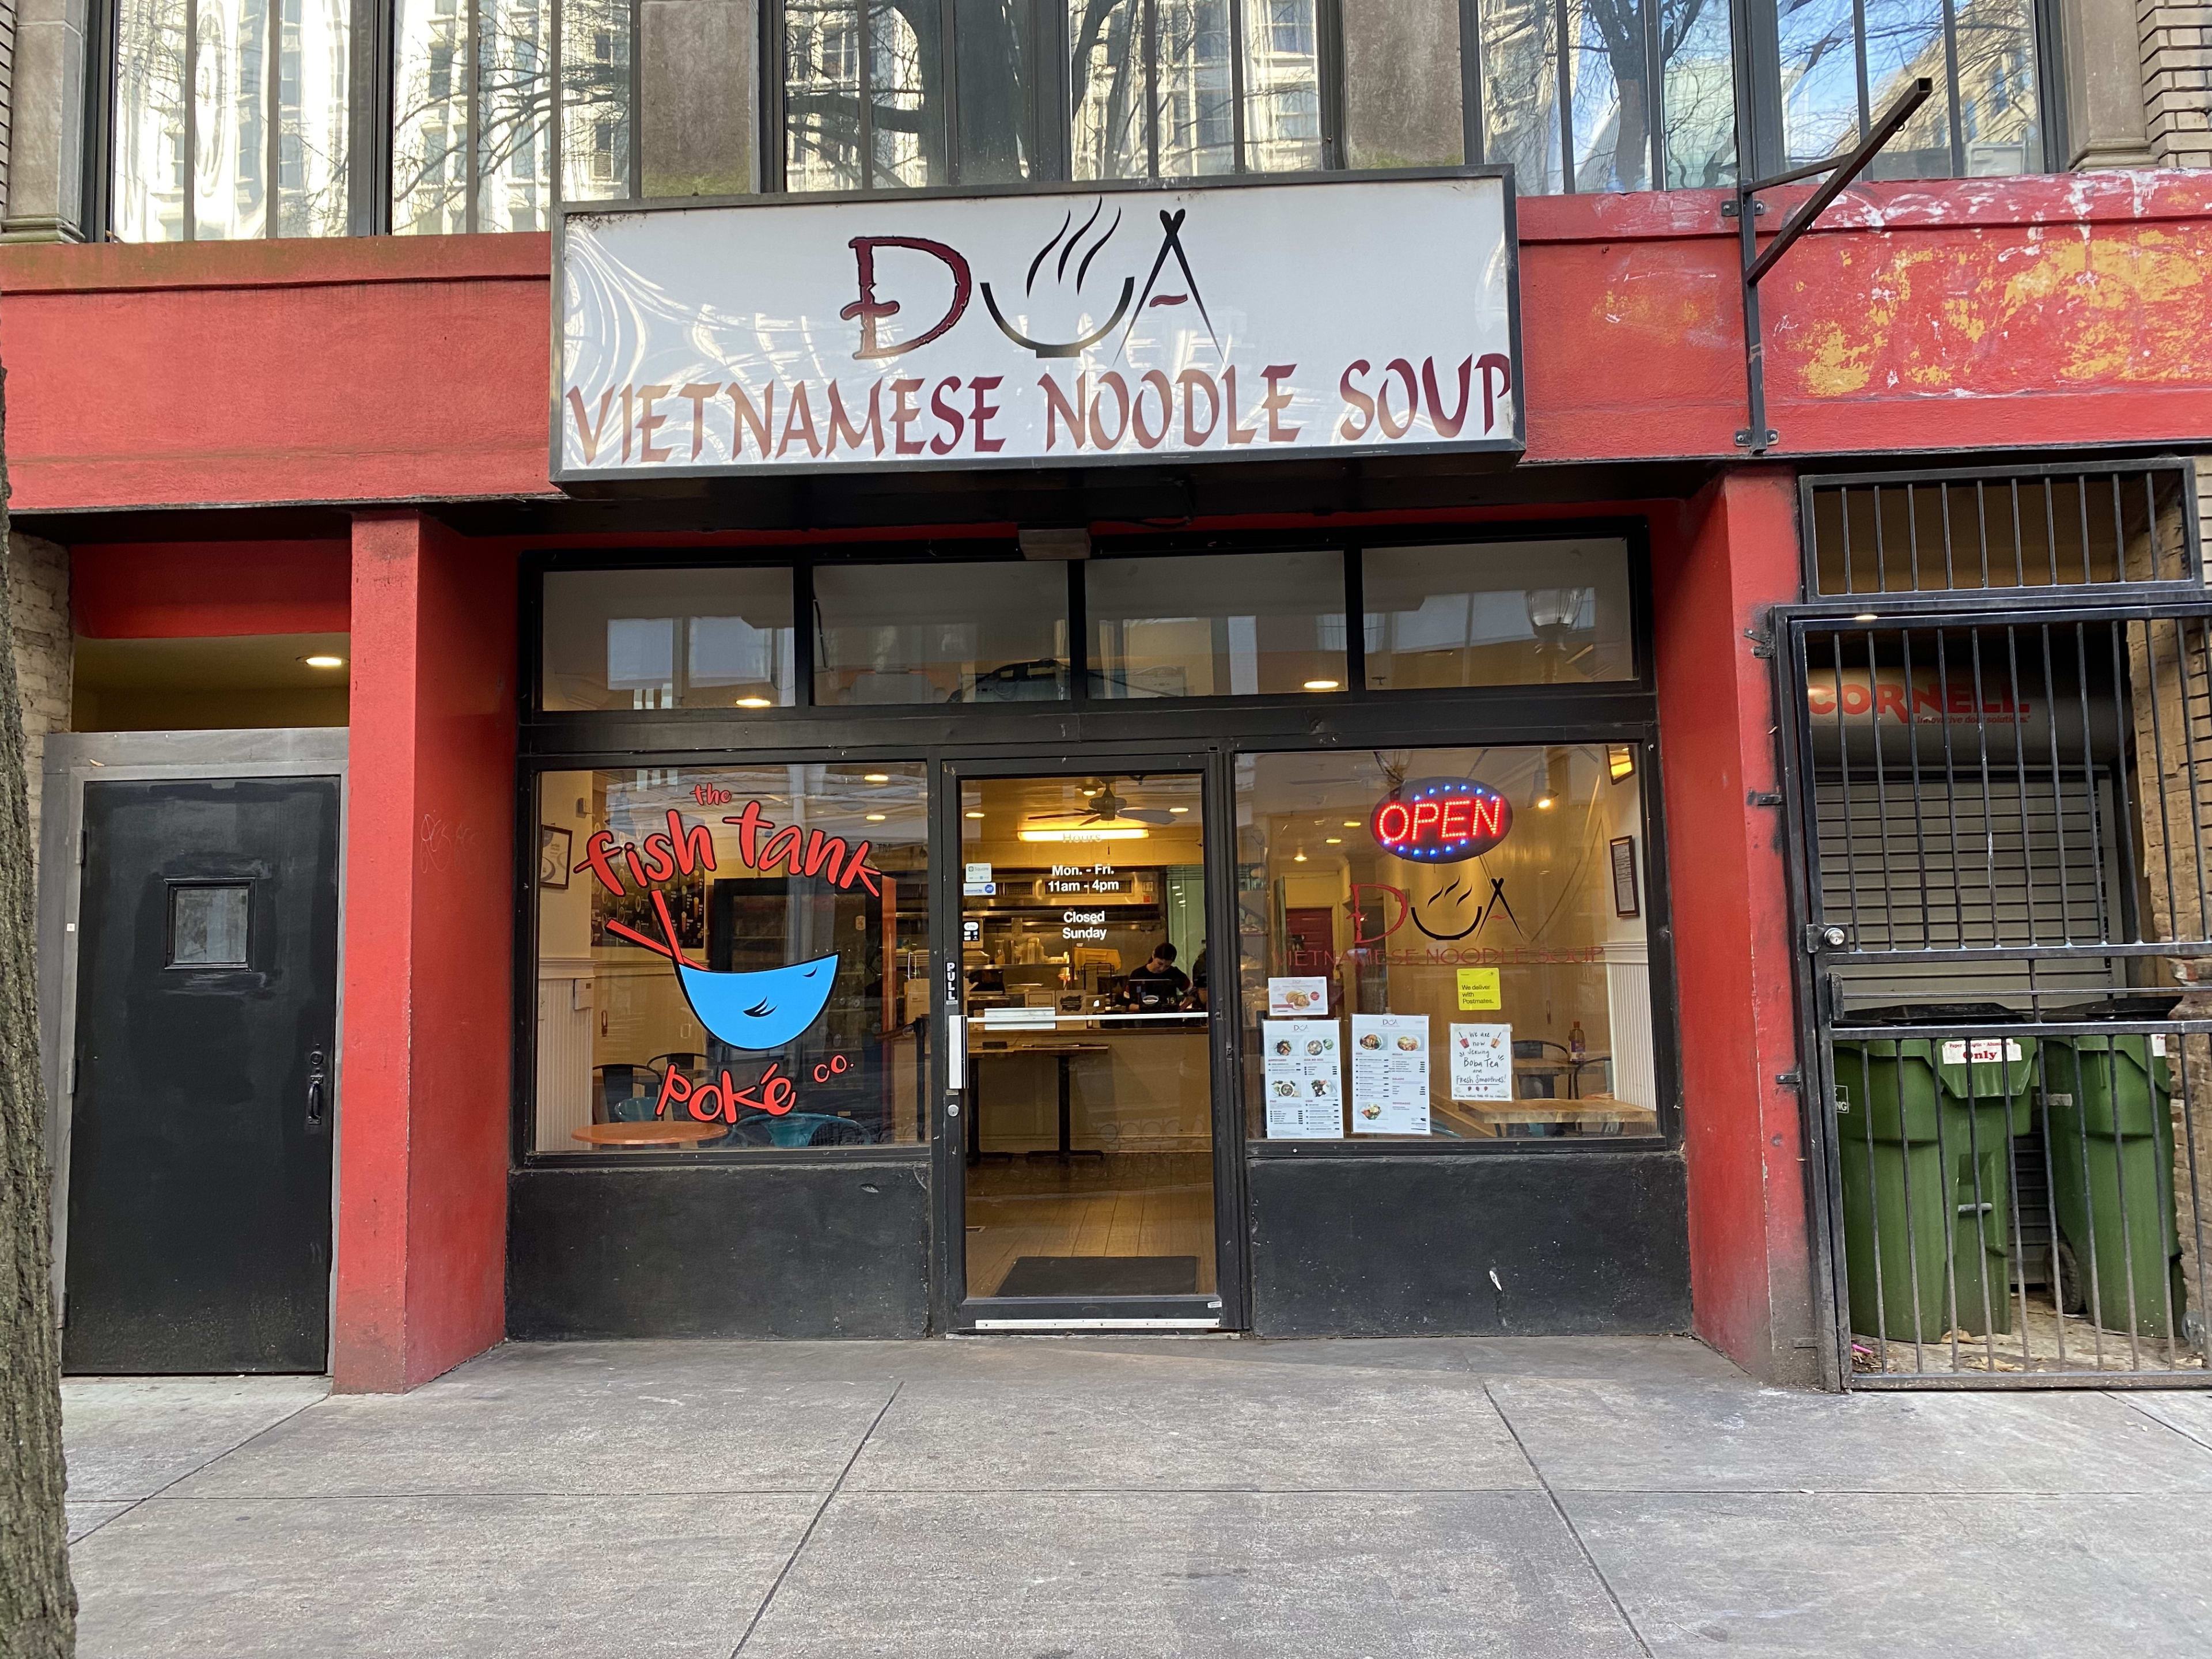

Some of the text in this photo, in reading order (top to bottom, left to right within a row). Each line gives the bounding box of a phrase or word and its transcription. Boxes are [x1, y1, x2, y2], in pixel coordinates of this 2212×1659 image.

[566, 353, 1510, 465] VIETNAMESE NOODLE SOUP
[1808, 683, 2030, 724] CORNELL
[691, 782, 732, 806] the
[1376, 797, 1501, 842] OPEN
[1063, 833, 1102, 843] Hours
[573, 809, 717, 897] fish
[723, 800, 884, 897] tank
[1052, 865, 1083, 876] Mon.
[1094, 863, 1115, 875] Fri.
[1048, 881, 1081, 892] 11am
[1092, 879, 1119, 893] 4pm
[1063, 911, 1105, 923] Closed
[1062, 927, 1107, 940] Sunday
[1274, 946, 1604, 967] VIETNAMESE NOODLE SOUP
[946, 962, 956, 1000] PULL
[1468, 1048, 1490, 1058] Serving
[1963, 1050, 1997, 1060] Only
[1464, 1057, 1499, 1067] Boba Tea
[1456, 1075, 1474, 1084] Fresh
[656, 1063, 796, 1123] poké
